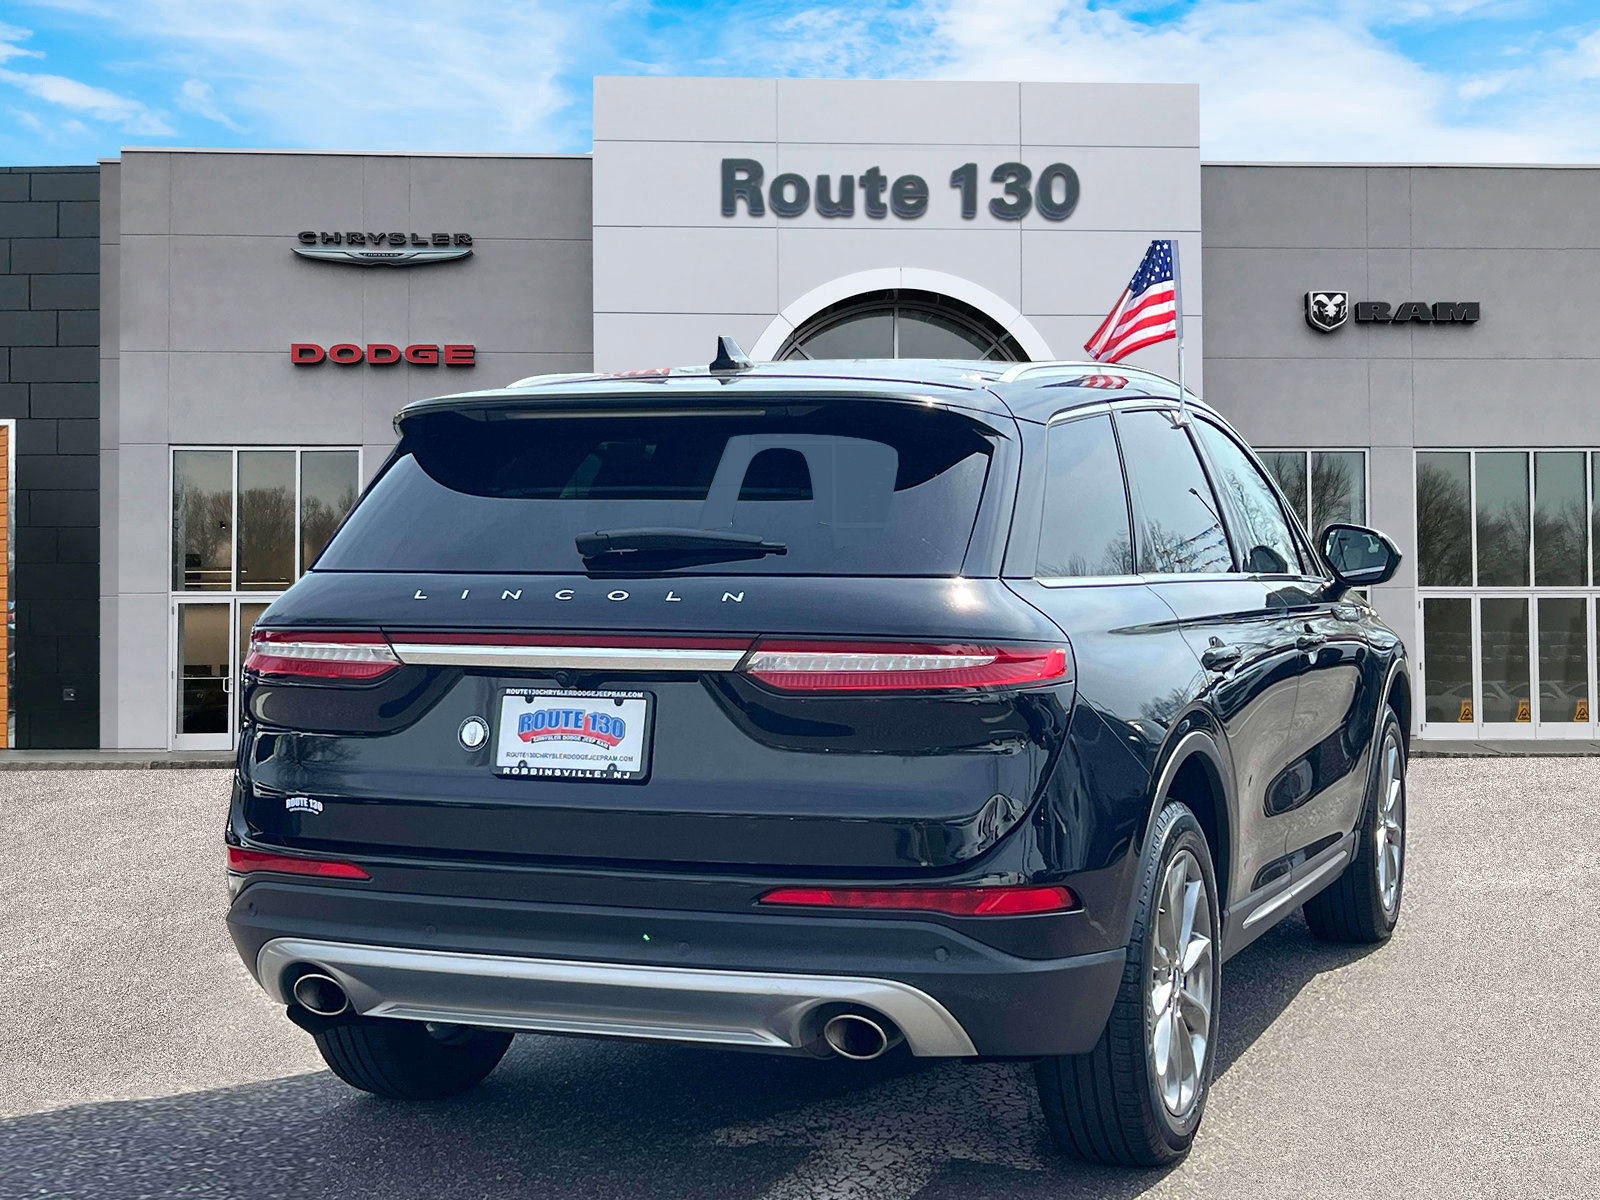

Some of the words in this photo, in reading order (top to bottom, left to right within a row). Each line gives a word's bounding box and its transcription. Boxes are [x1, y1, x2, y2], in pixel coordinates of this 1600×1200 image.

[720, 158, 929, 217] Route
[950, 162, 1080, 220] 130
[297, 231, 473, 245] CHRYSLER
[1355, 302, 1480, 322] RAM
[291, 344, 475, 364] DODGE
[413, 589, 745, 602] LINCOLN
[505, 688, 644, 698] ROUTE130CHRYSLERDODGEJEEPRAM.COM
[518, 709, 585, 733] ROUTE
[588, 711, 626, 740] 130
[506, 751, 634, 762] ROUTE130CHRYSLERDODGEJEEPRAM.COM
[503, 767, 607, 778] ROBBINSVILLE,
[286, 797, 309, 809] ROUTE
[309, 799, 323, 812] 130
